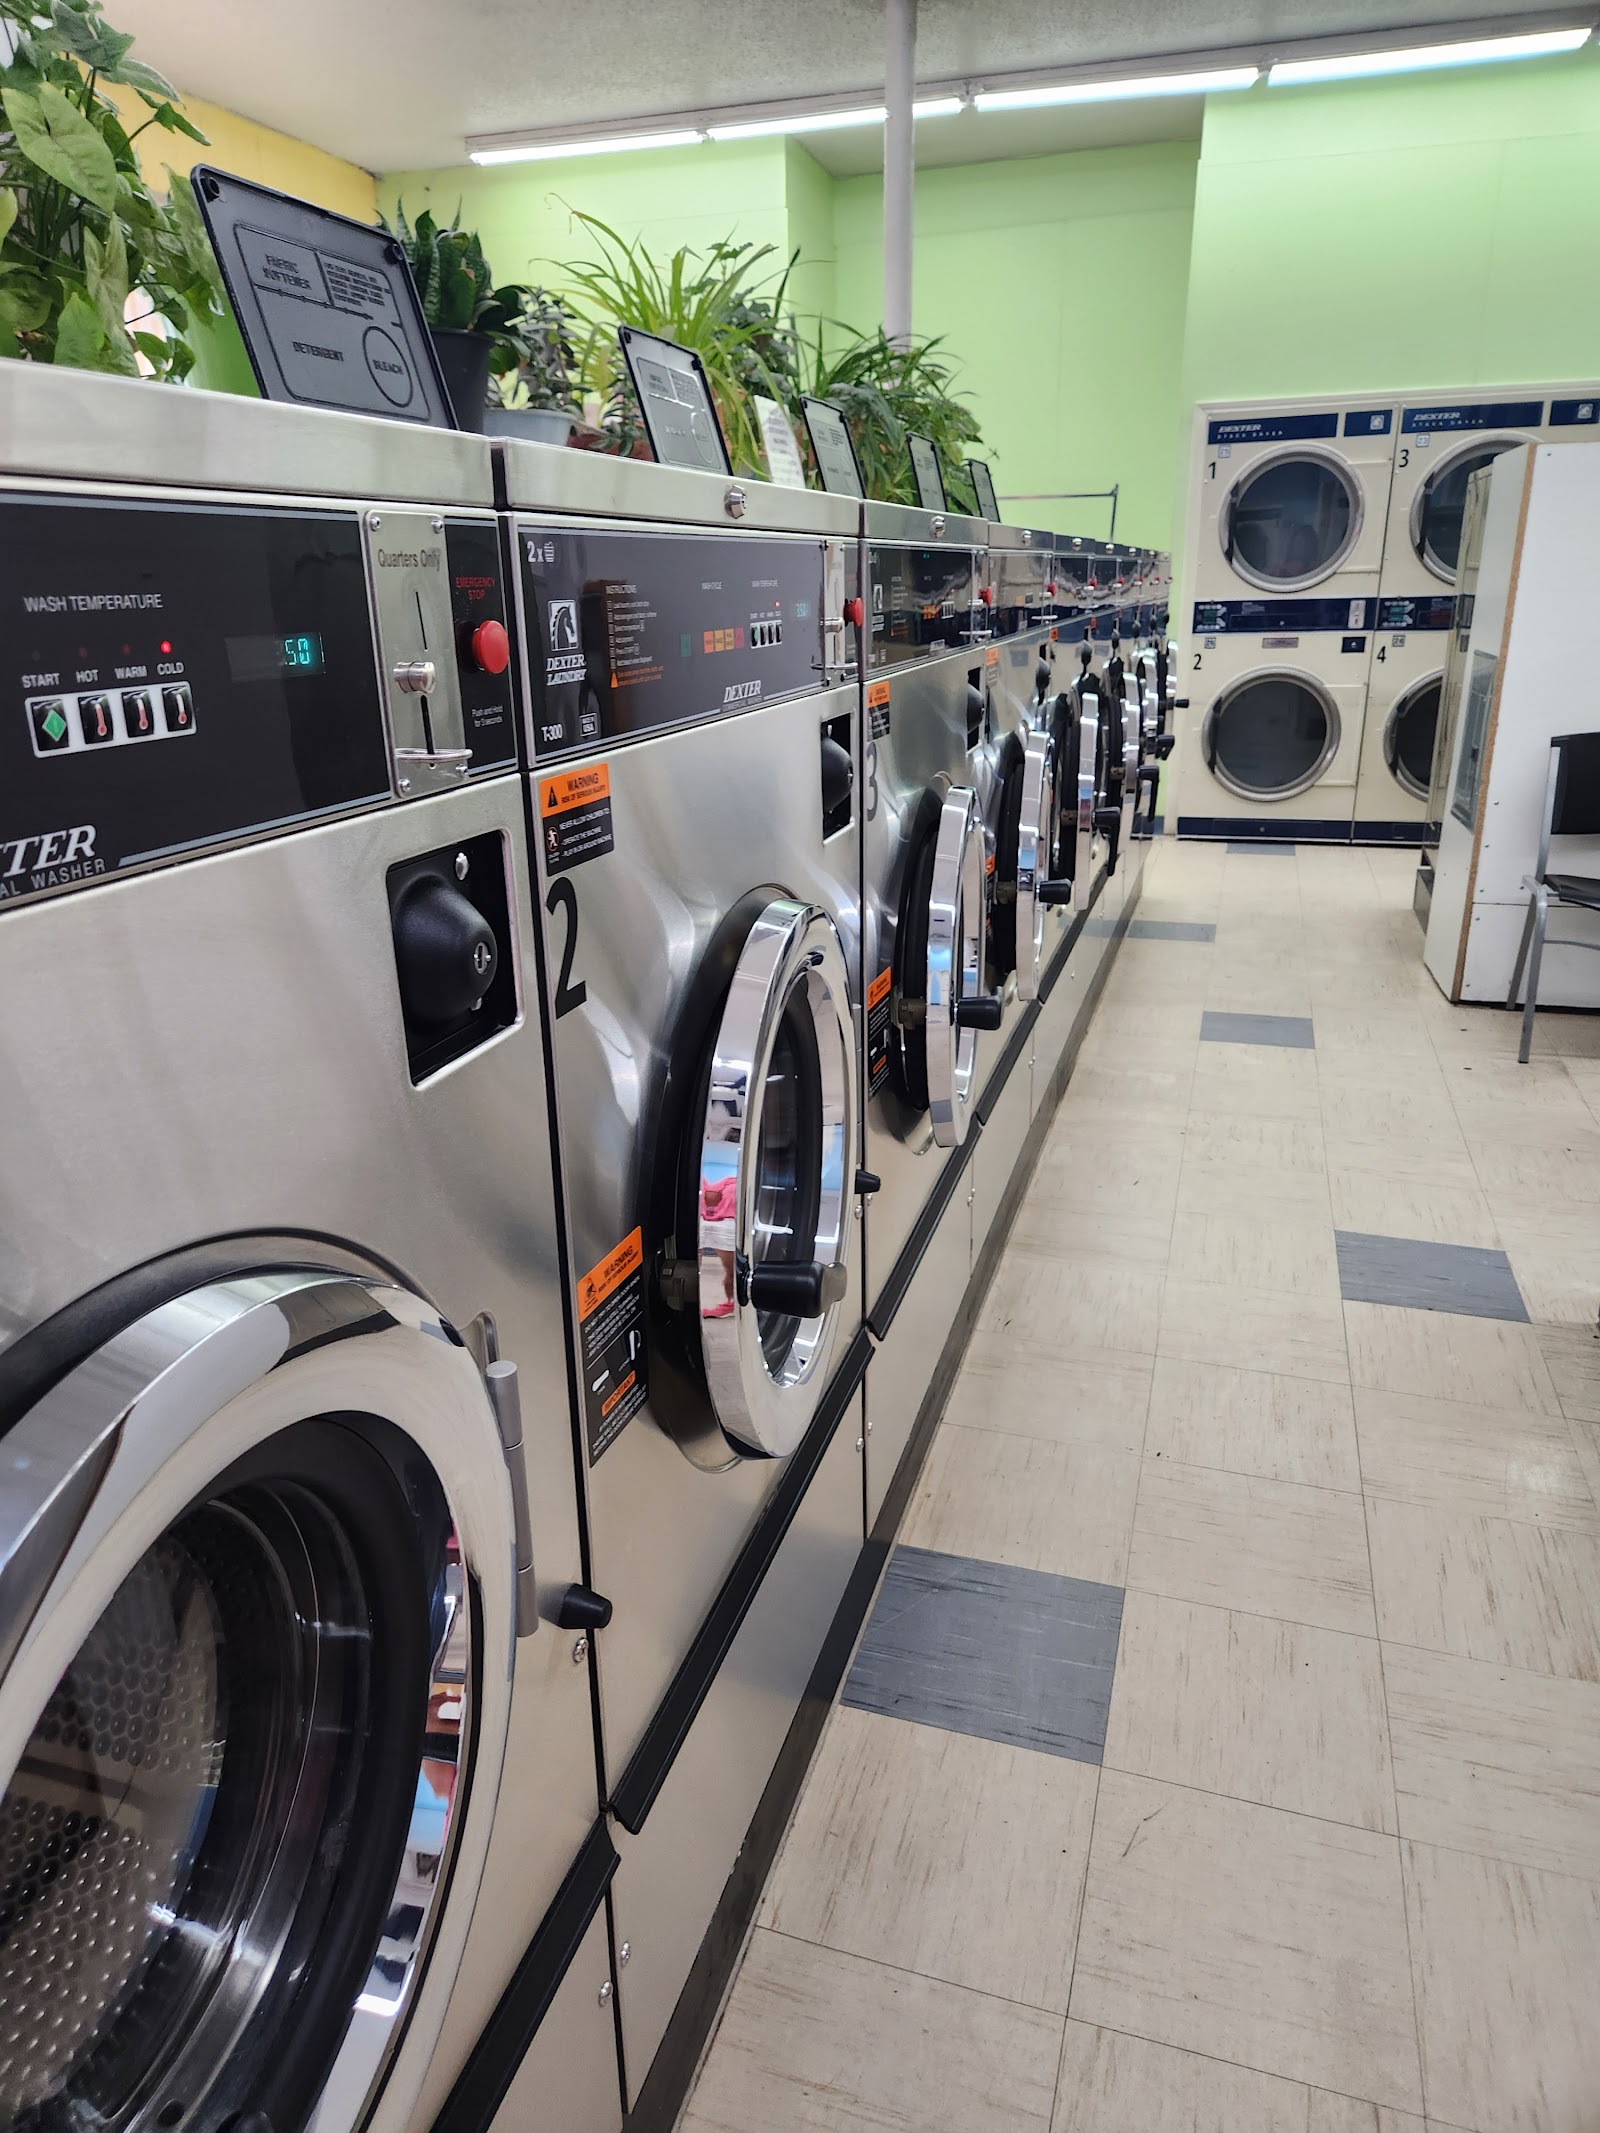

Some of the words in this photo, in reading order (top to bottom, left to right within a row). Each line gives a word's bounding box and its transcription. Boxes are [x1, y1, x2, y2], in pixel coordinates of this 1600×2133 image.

[265, 254, 298, 273] FABRIC
[262, 266, 312, 290] SOFTENER
[292, 340, 344, 362] DETERGENT
[372, 359, 404, 375] BLEACH
[1398, 449, 1409, 468] 3
[1208, 461, 1216, 479] 1
[378, 549, 418, 568] Quarters
[420, 549, 441, 572] Only
[456, 577, 496, 588] EMERGENCY
[24, 597, 67, 612] WASH
[69, 594, 163, 610] TEMPERATURE
[468, 589, 486, 600] STOP
[546, 654, 587, 671] DEXTER
[1193, 653, 1202, 671] 2
[1376, 645, 1386, 663] 4
[76, 669, 99, 682] HOT
[115, 666, 148, 679] WARM
[157, 662, 185, 675] COLD
[547, 669, 588, 686] LAUNDRY
[22, 673, 60, 688] START
[723, 680, 761, 703] DEXTER
[541, 724, 563, 741] T-300
[567, 772, 599, 792] WARNING
[867, 741, 878, 822] 3
[561, 795, 569, 803] RISK
[576, 788, 592, 798] SERIOUS
[0, 825, 97, 878] TER
[30, 858, 106, 889] WASHER
[546, 876, 588, 1020] 2
[604, 1245, 633, 1278] WARNING
